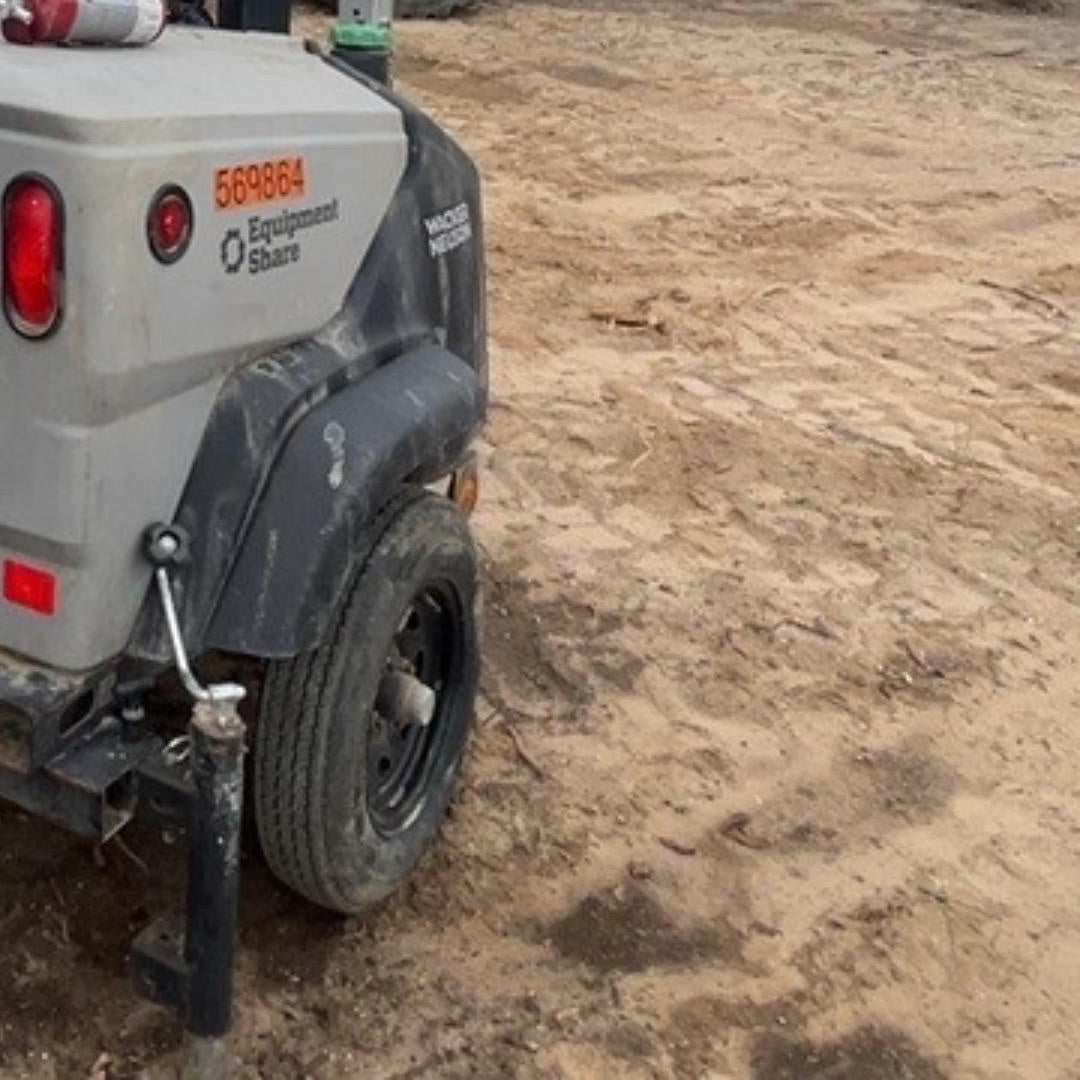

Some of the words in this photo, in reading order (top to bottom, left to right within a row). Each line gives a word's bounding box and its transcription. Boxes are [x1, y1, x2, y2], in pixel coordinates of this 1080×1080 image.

[216, 158, 304, 208] 569864
[248, 197, 338, 243] Equipment
[248, 242, 300, 273] Share
